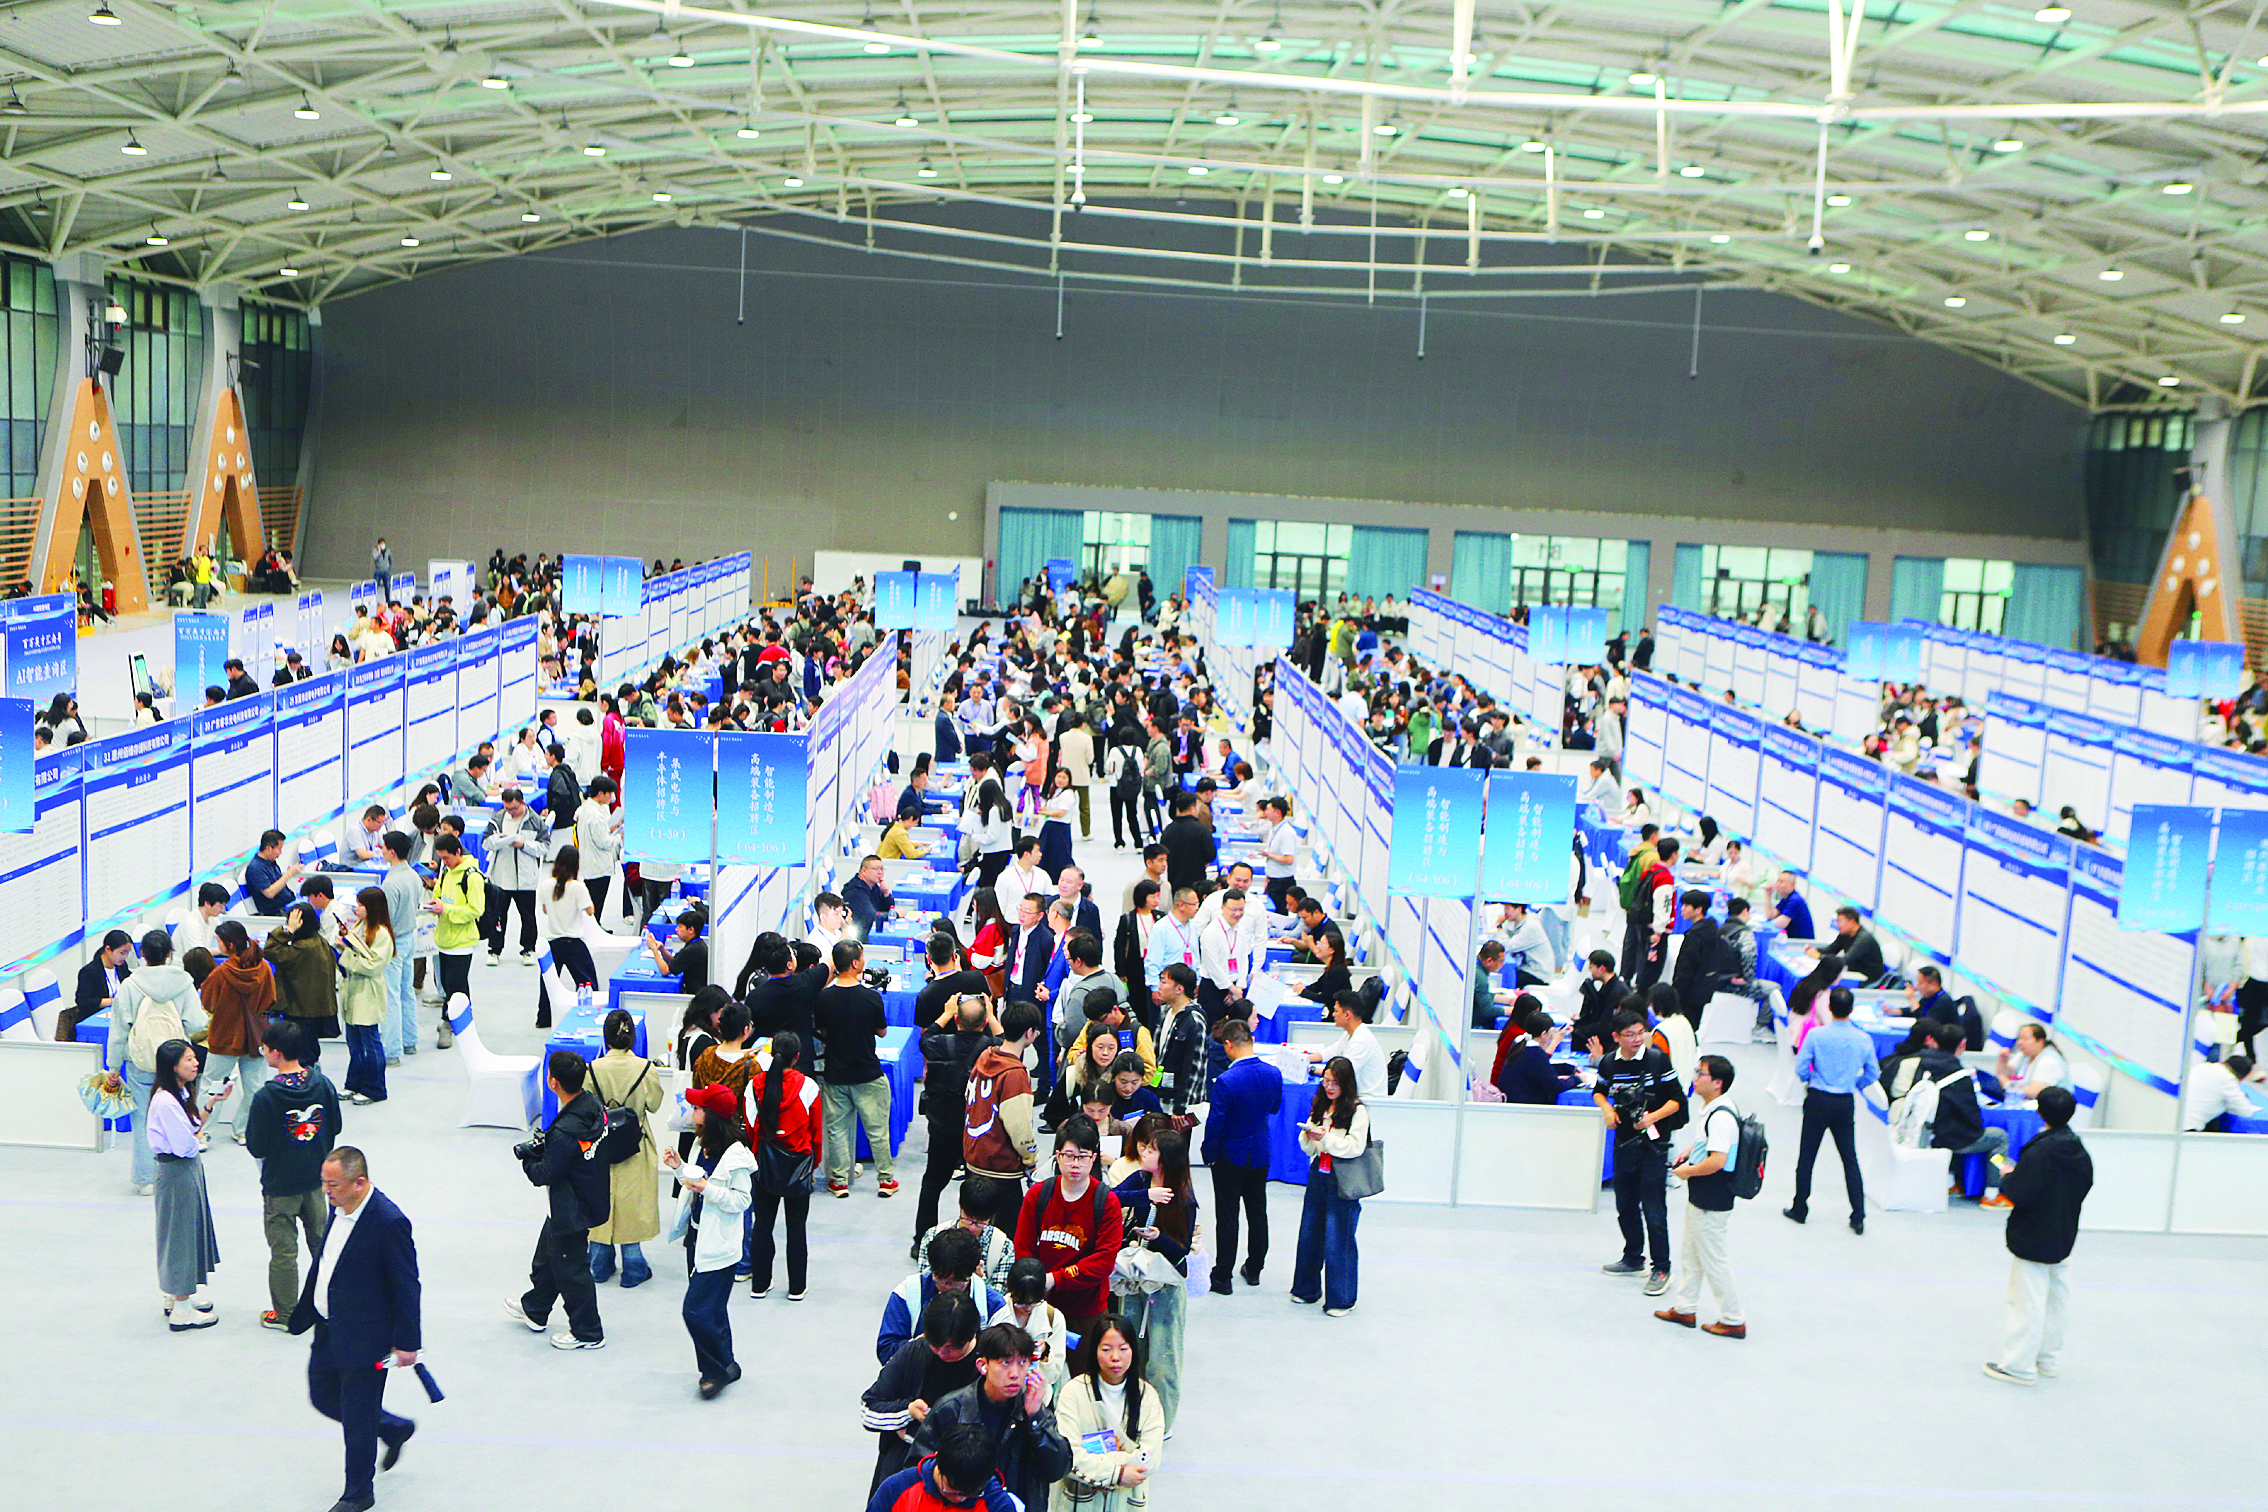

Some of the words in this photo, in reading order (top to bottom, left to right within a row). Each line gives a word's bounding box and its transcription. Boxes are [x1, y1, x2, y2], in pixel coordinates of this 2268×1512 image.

[655, 751, 667, 821] 半导体招聘区
[670, 757, 682, 817] 集成电路与
[748, 753, 761, 835] 高端装备招聘区
[763, 765, 775, 824] 智能制造与
[1422, 785, 1438, 867] 高端装备招聘区
[1437, 798, 1452, 857] 智能制造与
[1529, 803, 1545, 862] 智能制造与
[1040, 1229, 1080, 1251] ARSENAL
